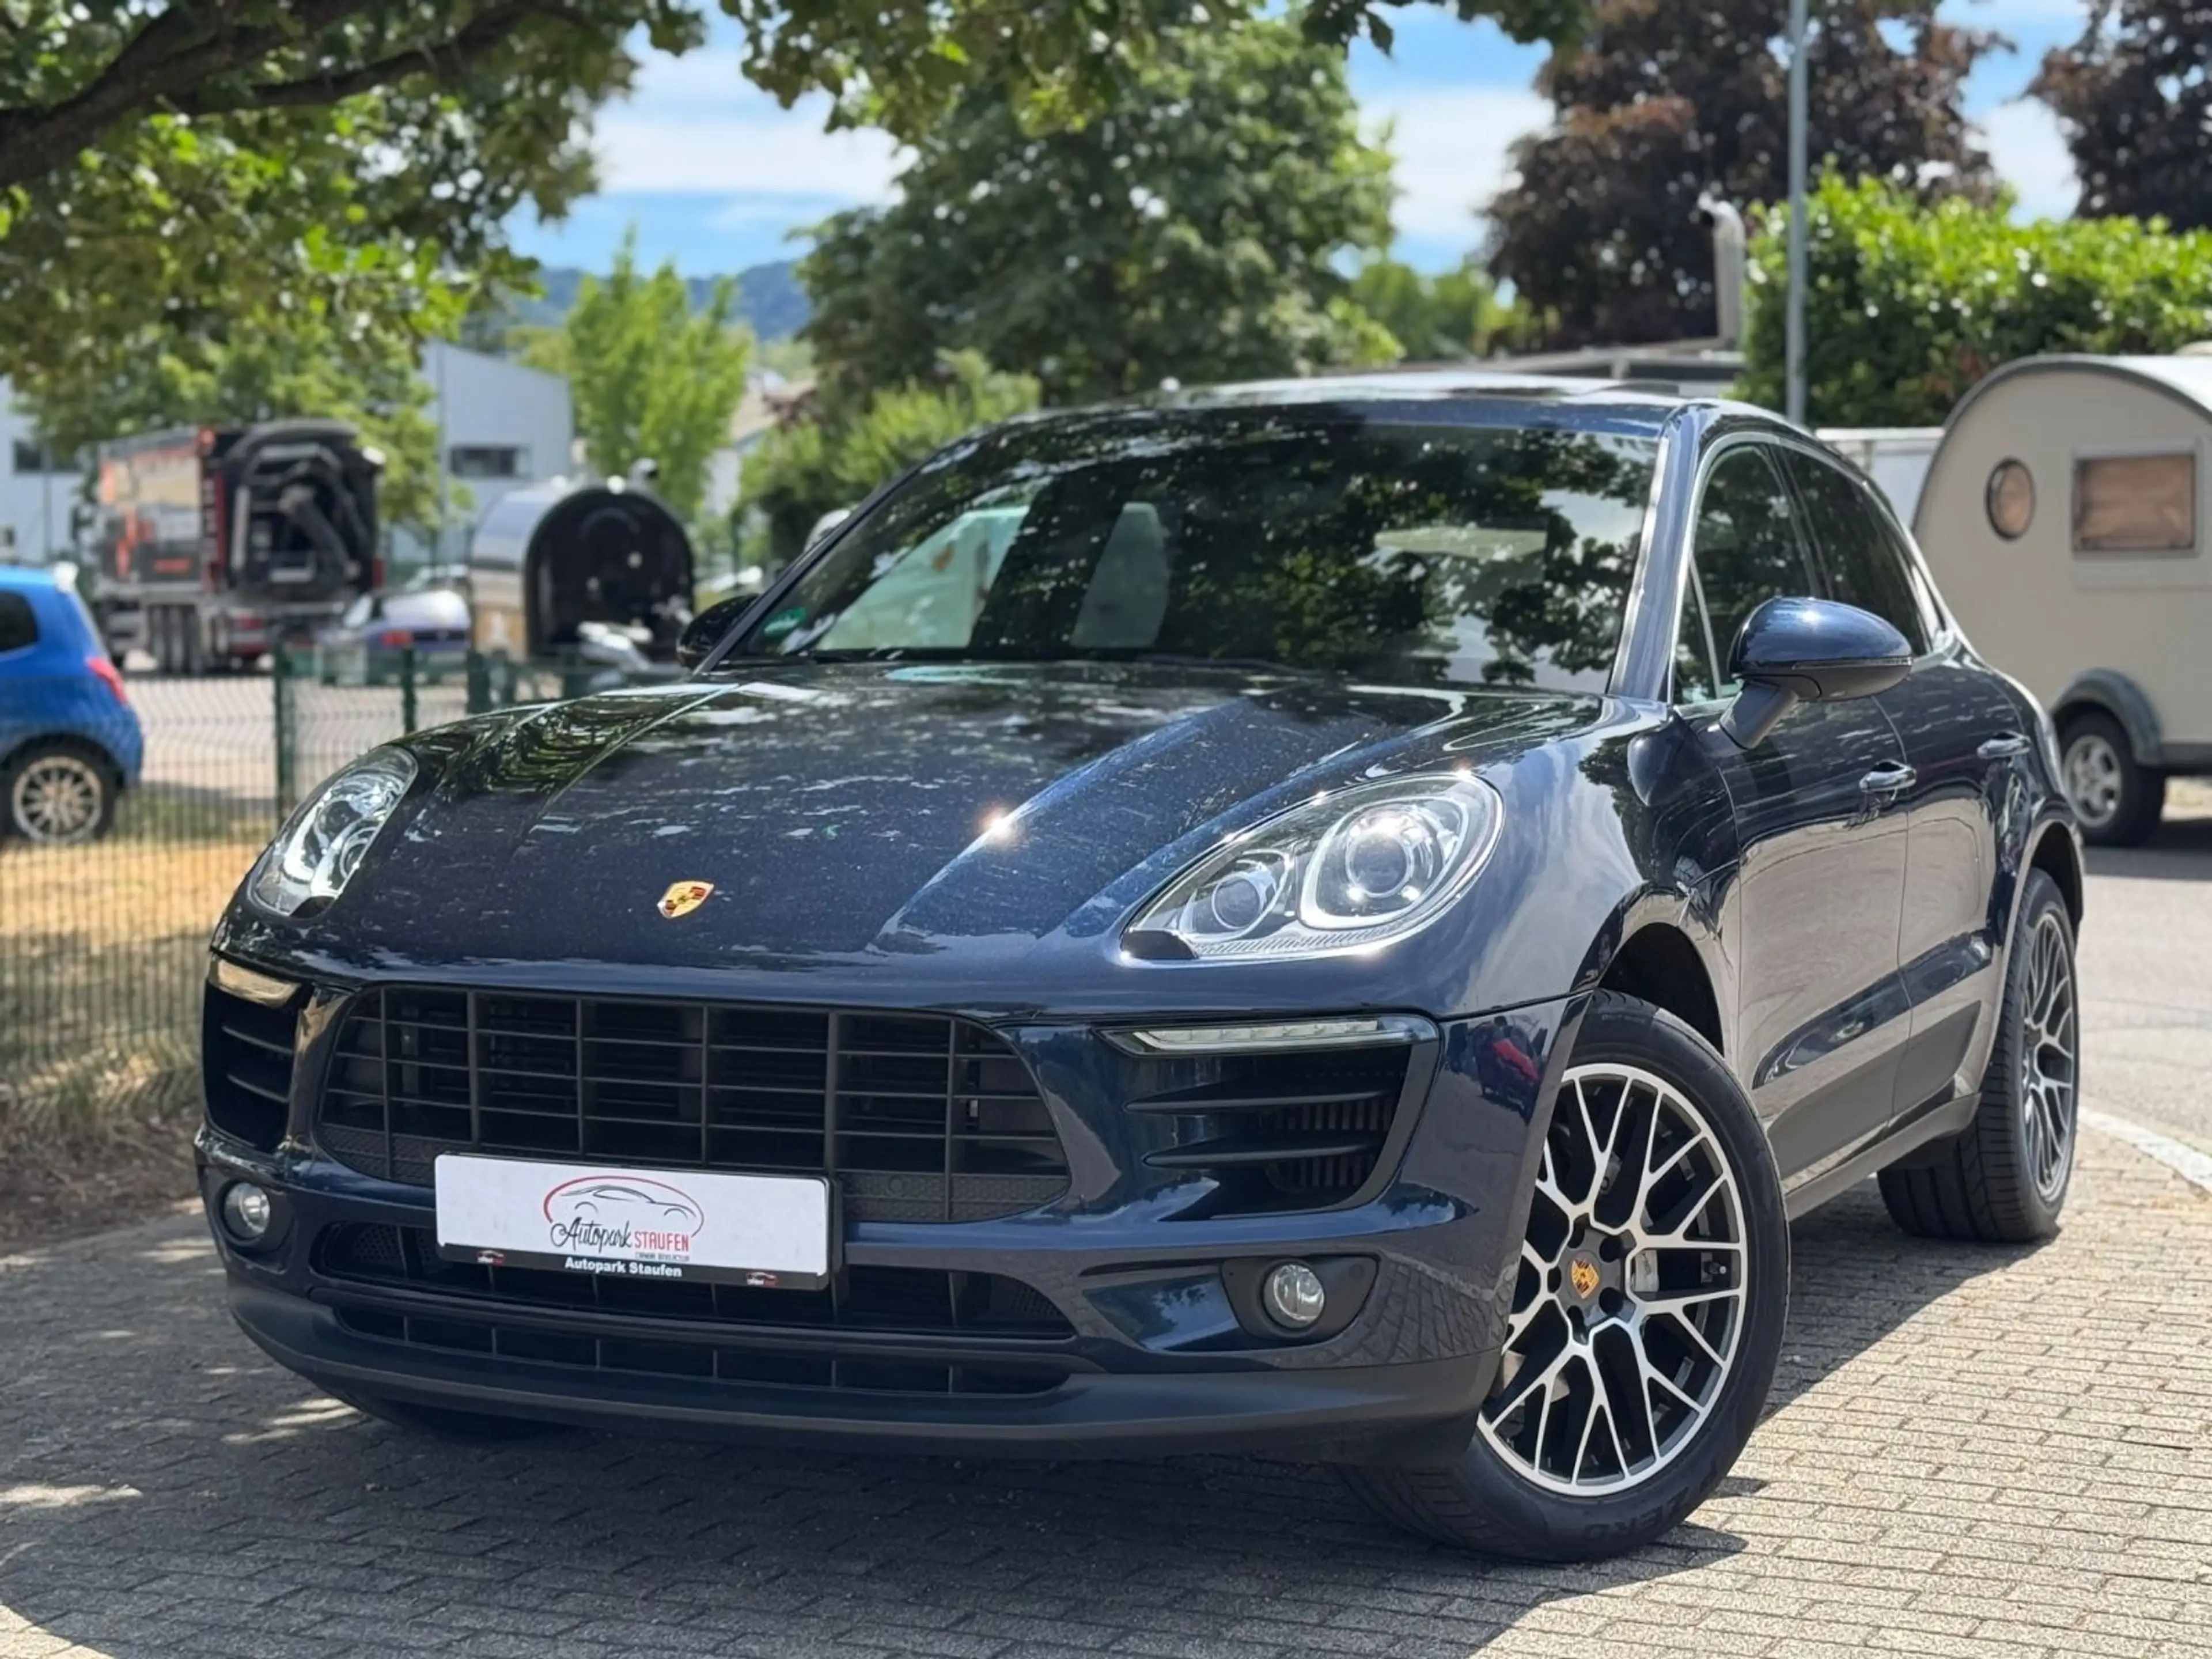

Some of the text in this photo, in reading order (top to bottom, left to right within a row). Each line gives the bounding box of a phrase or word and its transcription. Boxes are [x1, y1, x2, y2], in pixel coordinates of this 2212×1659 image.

[550, 1216, 689, 1253] Autopark STAUFEN
[565, 1257, 626, 1274] Autopark
[628, 1262, 682, 1277] Staufen
